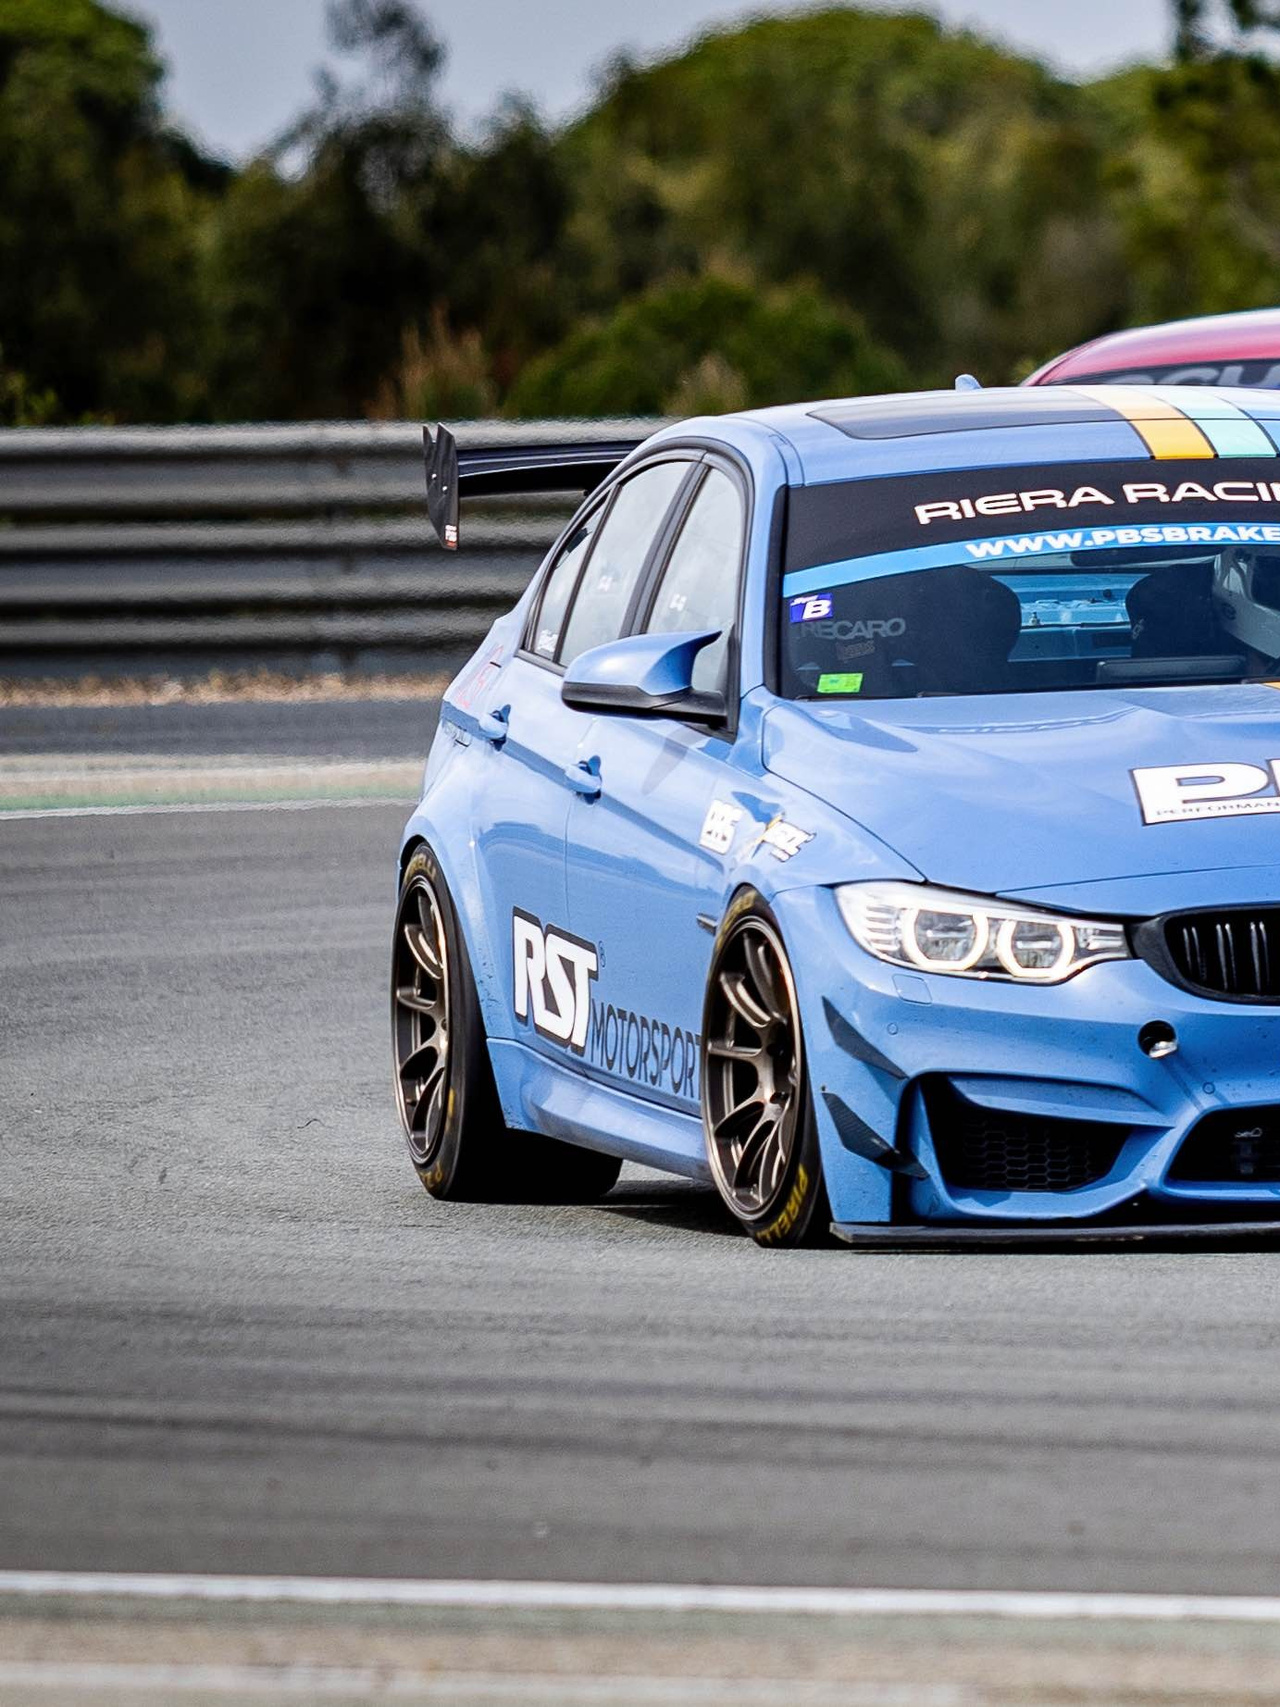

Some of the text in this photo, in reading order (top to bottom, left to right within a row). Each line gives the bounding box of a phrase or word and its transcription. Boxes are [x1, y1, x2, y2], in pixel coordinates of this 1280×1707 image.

[914, 486, 1115, 525] RIERA
[799, 618, 906, 640] RECARO
[802, 599, 832, 620] B
[513, 906, 599, 1057] RST
[591, 998, 703, 1099] MOTORSPORT
